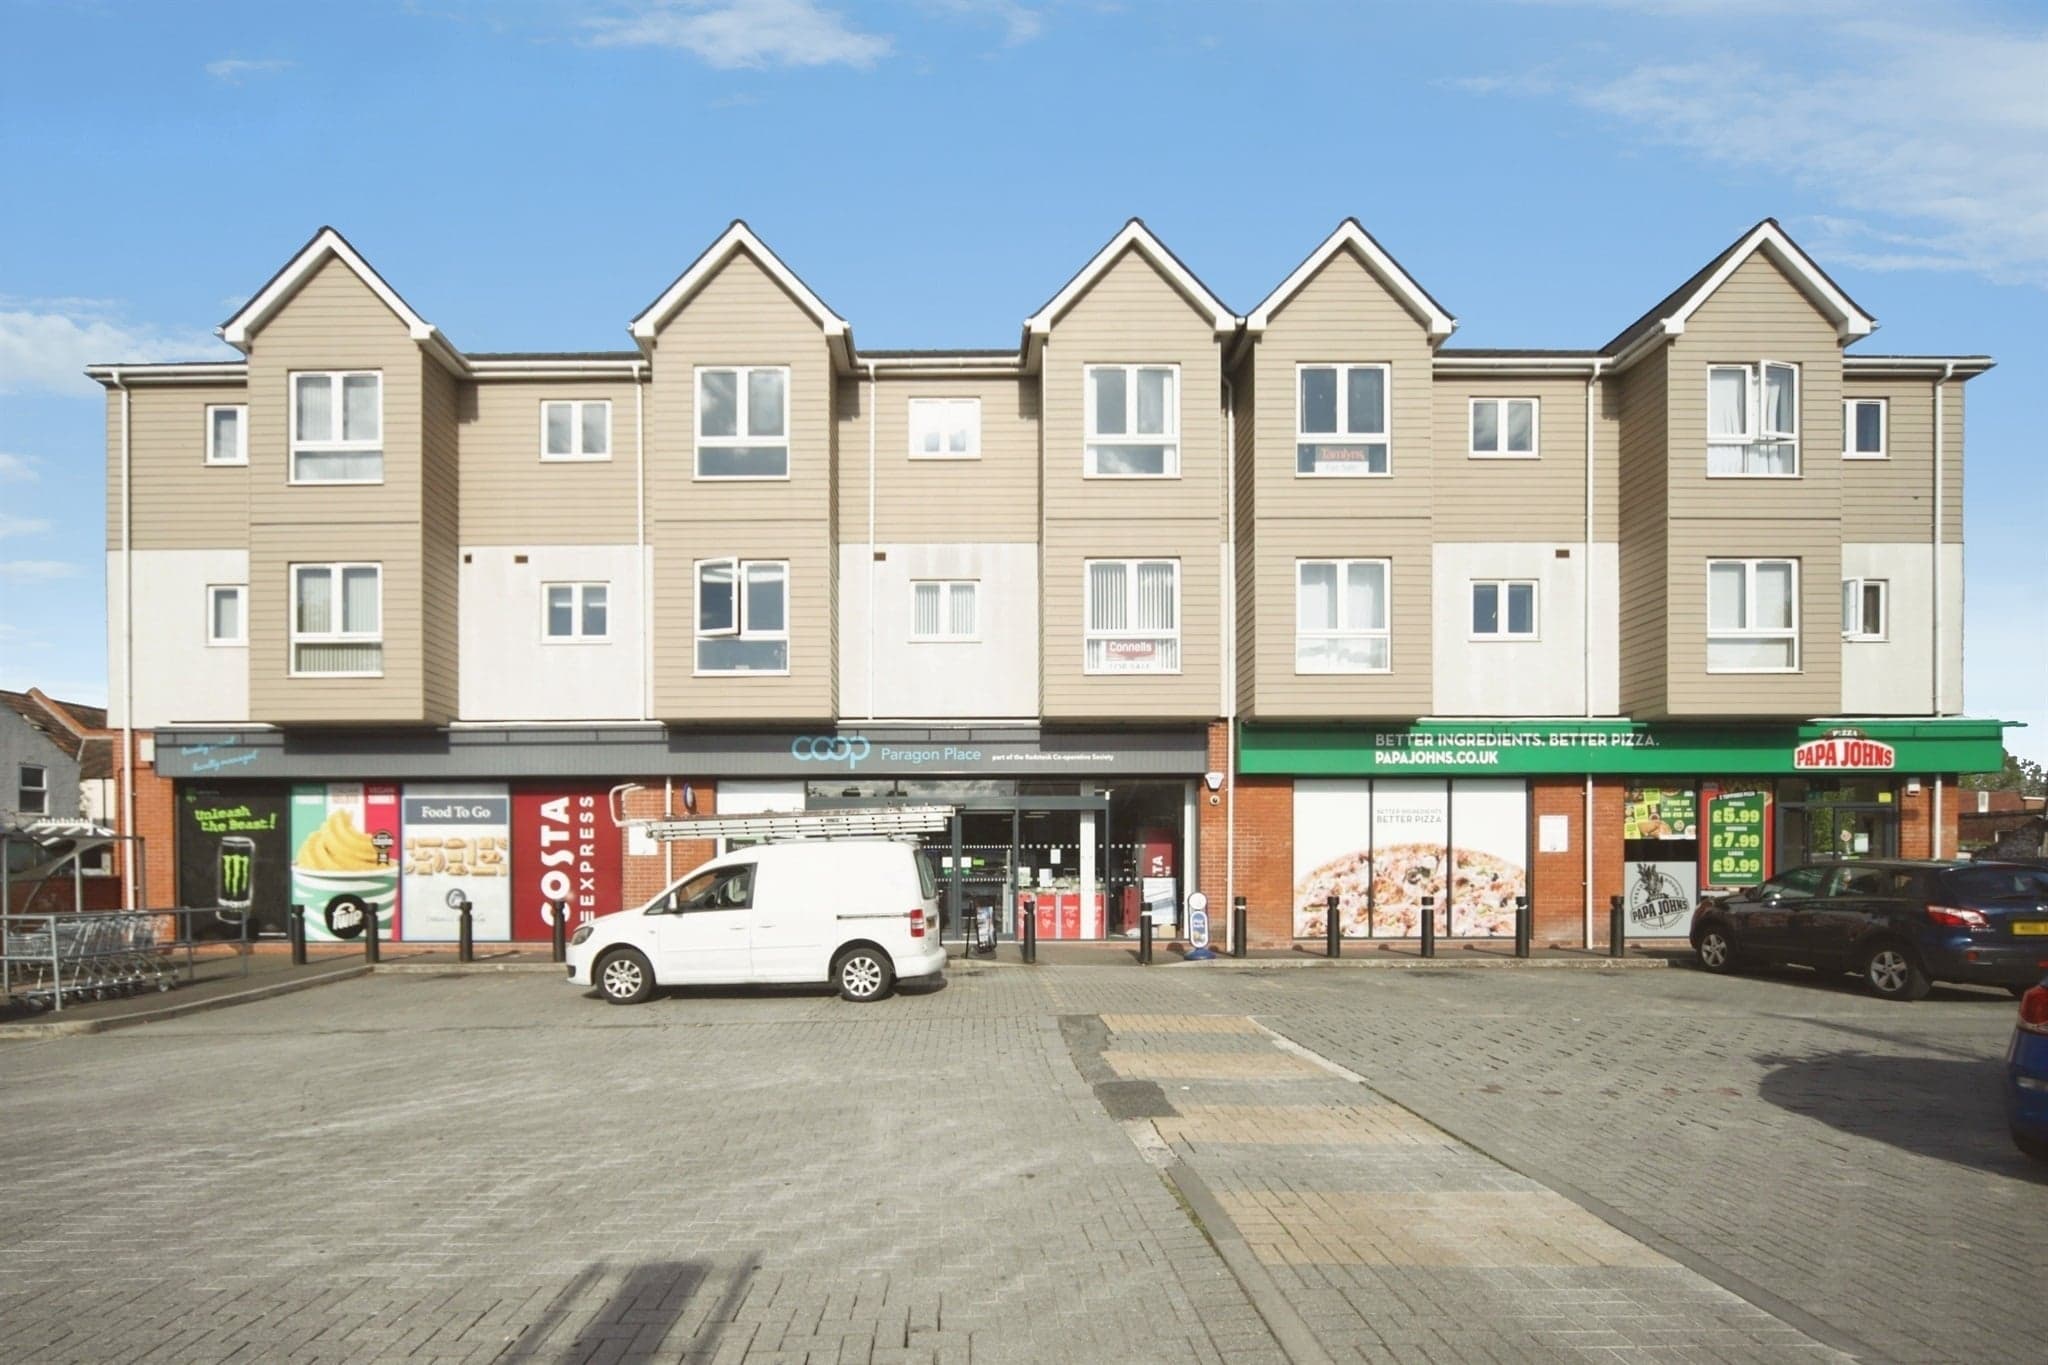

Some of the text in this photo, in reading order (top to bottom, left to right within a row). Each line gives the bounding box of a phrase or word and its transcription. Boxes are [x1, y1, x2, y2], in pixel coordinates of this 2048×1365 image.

[1110, 641, 1152, 652] Connells
[1375, 732, 1660, 747] BETTER INGREDIENTS. BETTER PIZZA.
[881, 747, 982, 764] Paragon Place
[1375, 751, 1499, 764] PAPAJOHNS.CO.UK
[1796, 741, 1893, 767] PAPA JOHNS
[421, 806, 491, 818] Food To Go
[1376, 815, 1442, 824] BETTER PIZZA
[1712, 807, 1760, 823] £5.99
[201, 820, 227, 832] the
[1712, 832, 1760, 848] £7.99
[579, 796, 595, 906] EXPRESS
[1712, 857, 1760, 873] £9.99
[1632, 903, 1657, 921] PAPA
